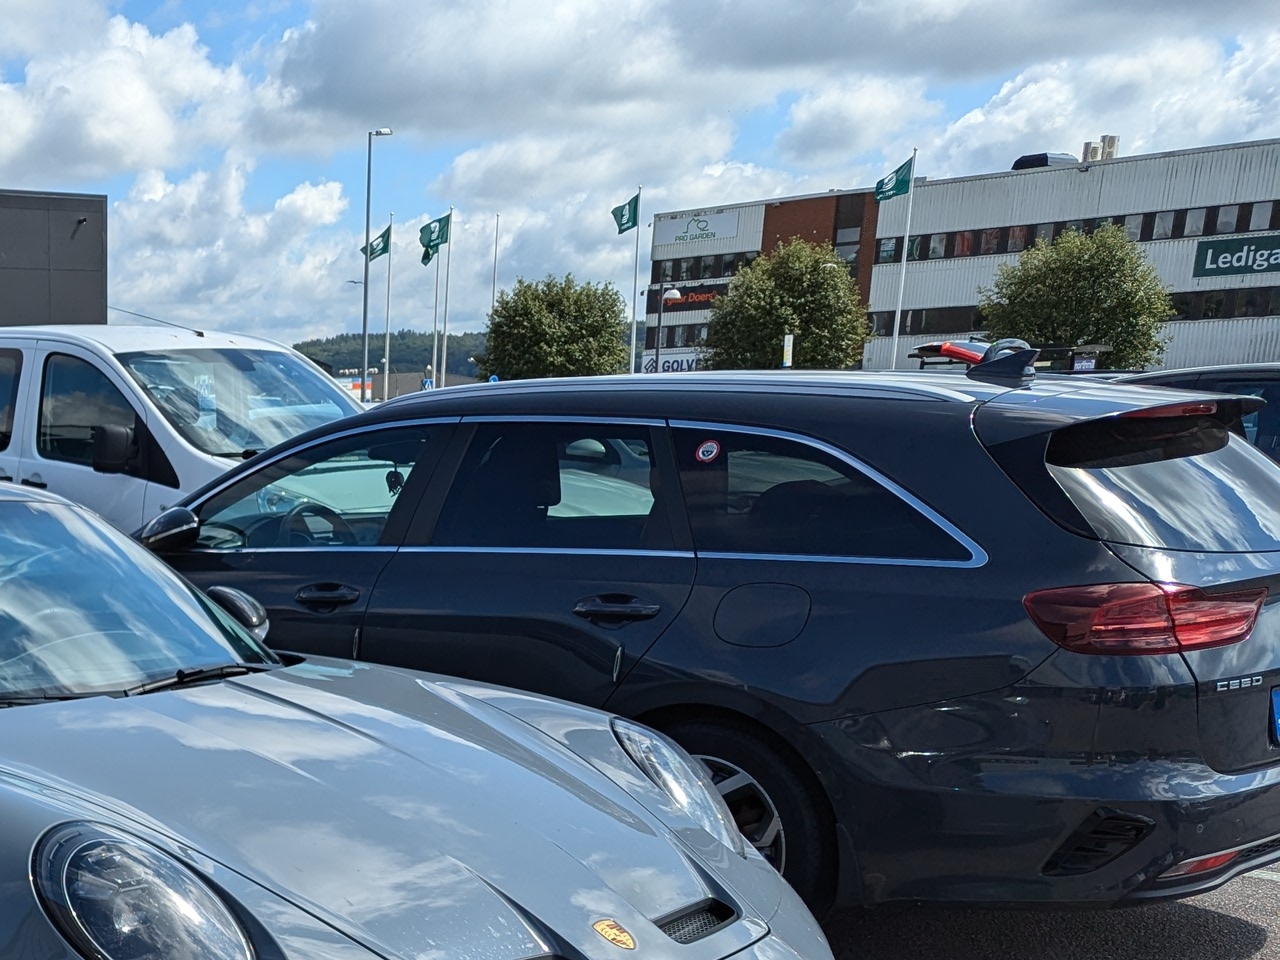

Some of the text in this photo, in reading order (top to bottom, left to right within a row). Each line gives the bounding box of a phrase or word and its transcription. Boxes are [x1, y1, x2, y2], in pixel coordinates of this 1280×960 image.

[675, 231, 716, 242] PRO GARDEN
[1217, 676, 1263, 691] CEED
